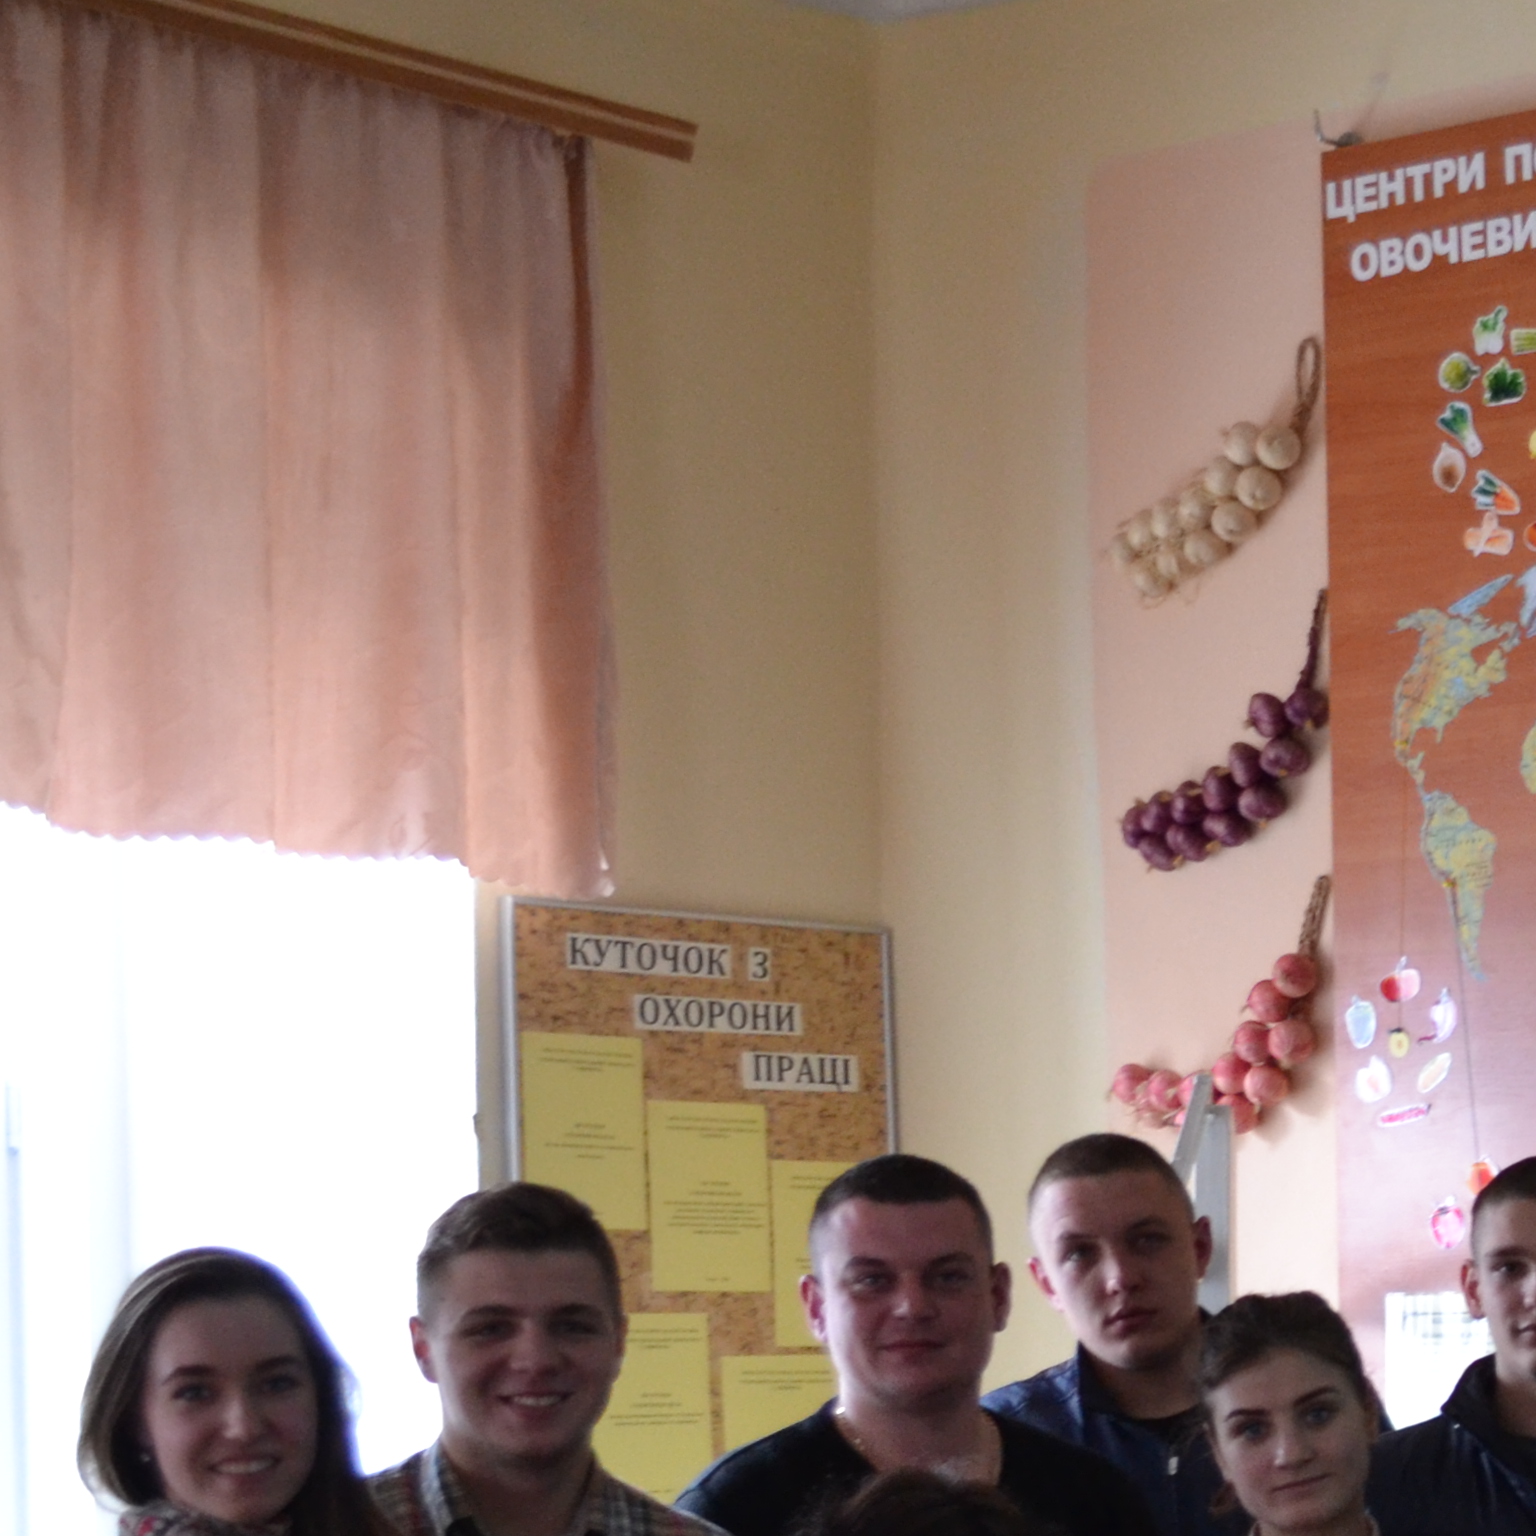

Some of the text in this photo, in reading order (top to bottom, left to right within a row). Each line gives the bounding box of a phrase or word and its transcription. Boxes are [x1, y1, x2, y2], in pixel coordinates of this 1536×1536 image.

[1325, 151, 1486, 223] ЦЕНТРИ
[569, 936, 728, 976] КУТОЧОК
[639, 997, 795, 1032] ОХОРОНИ
[753, 1054, 851, 1091] ПРАЦІ
